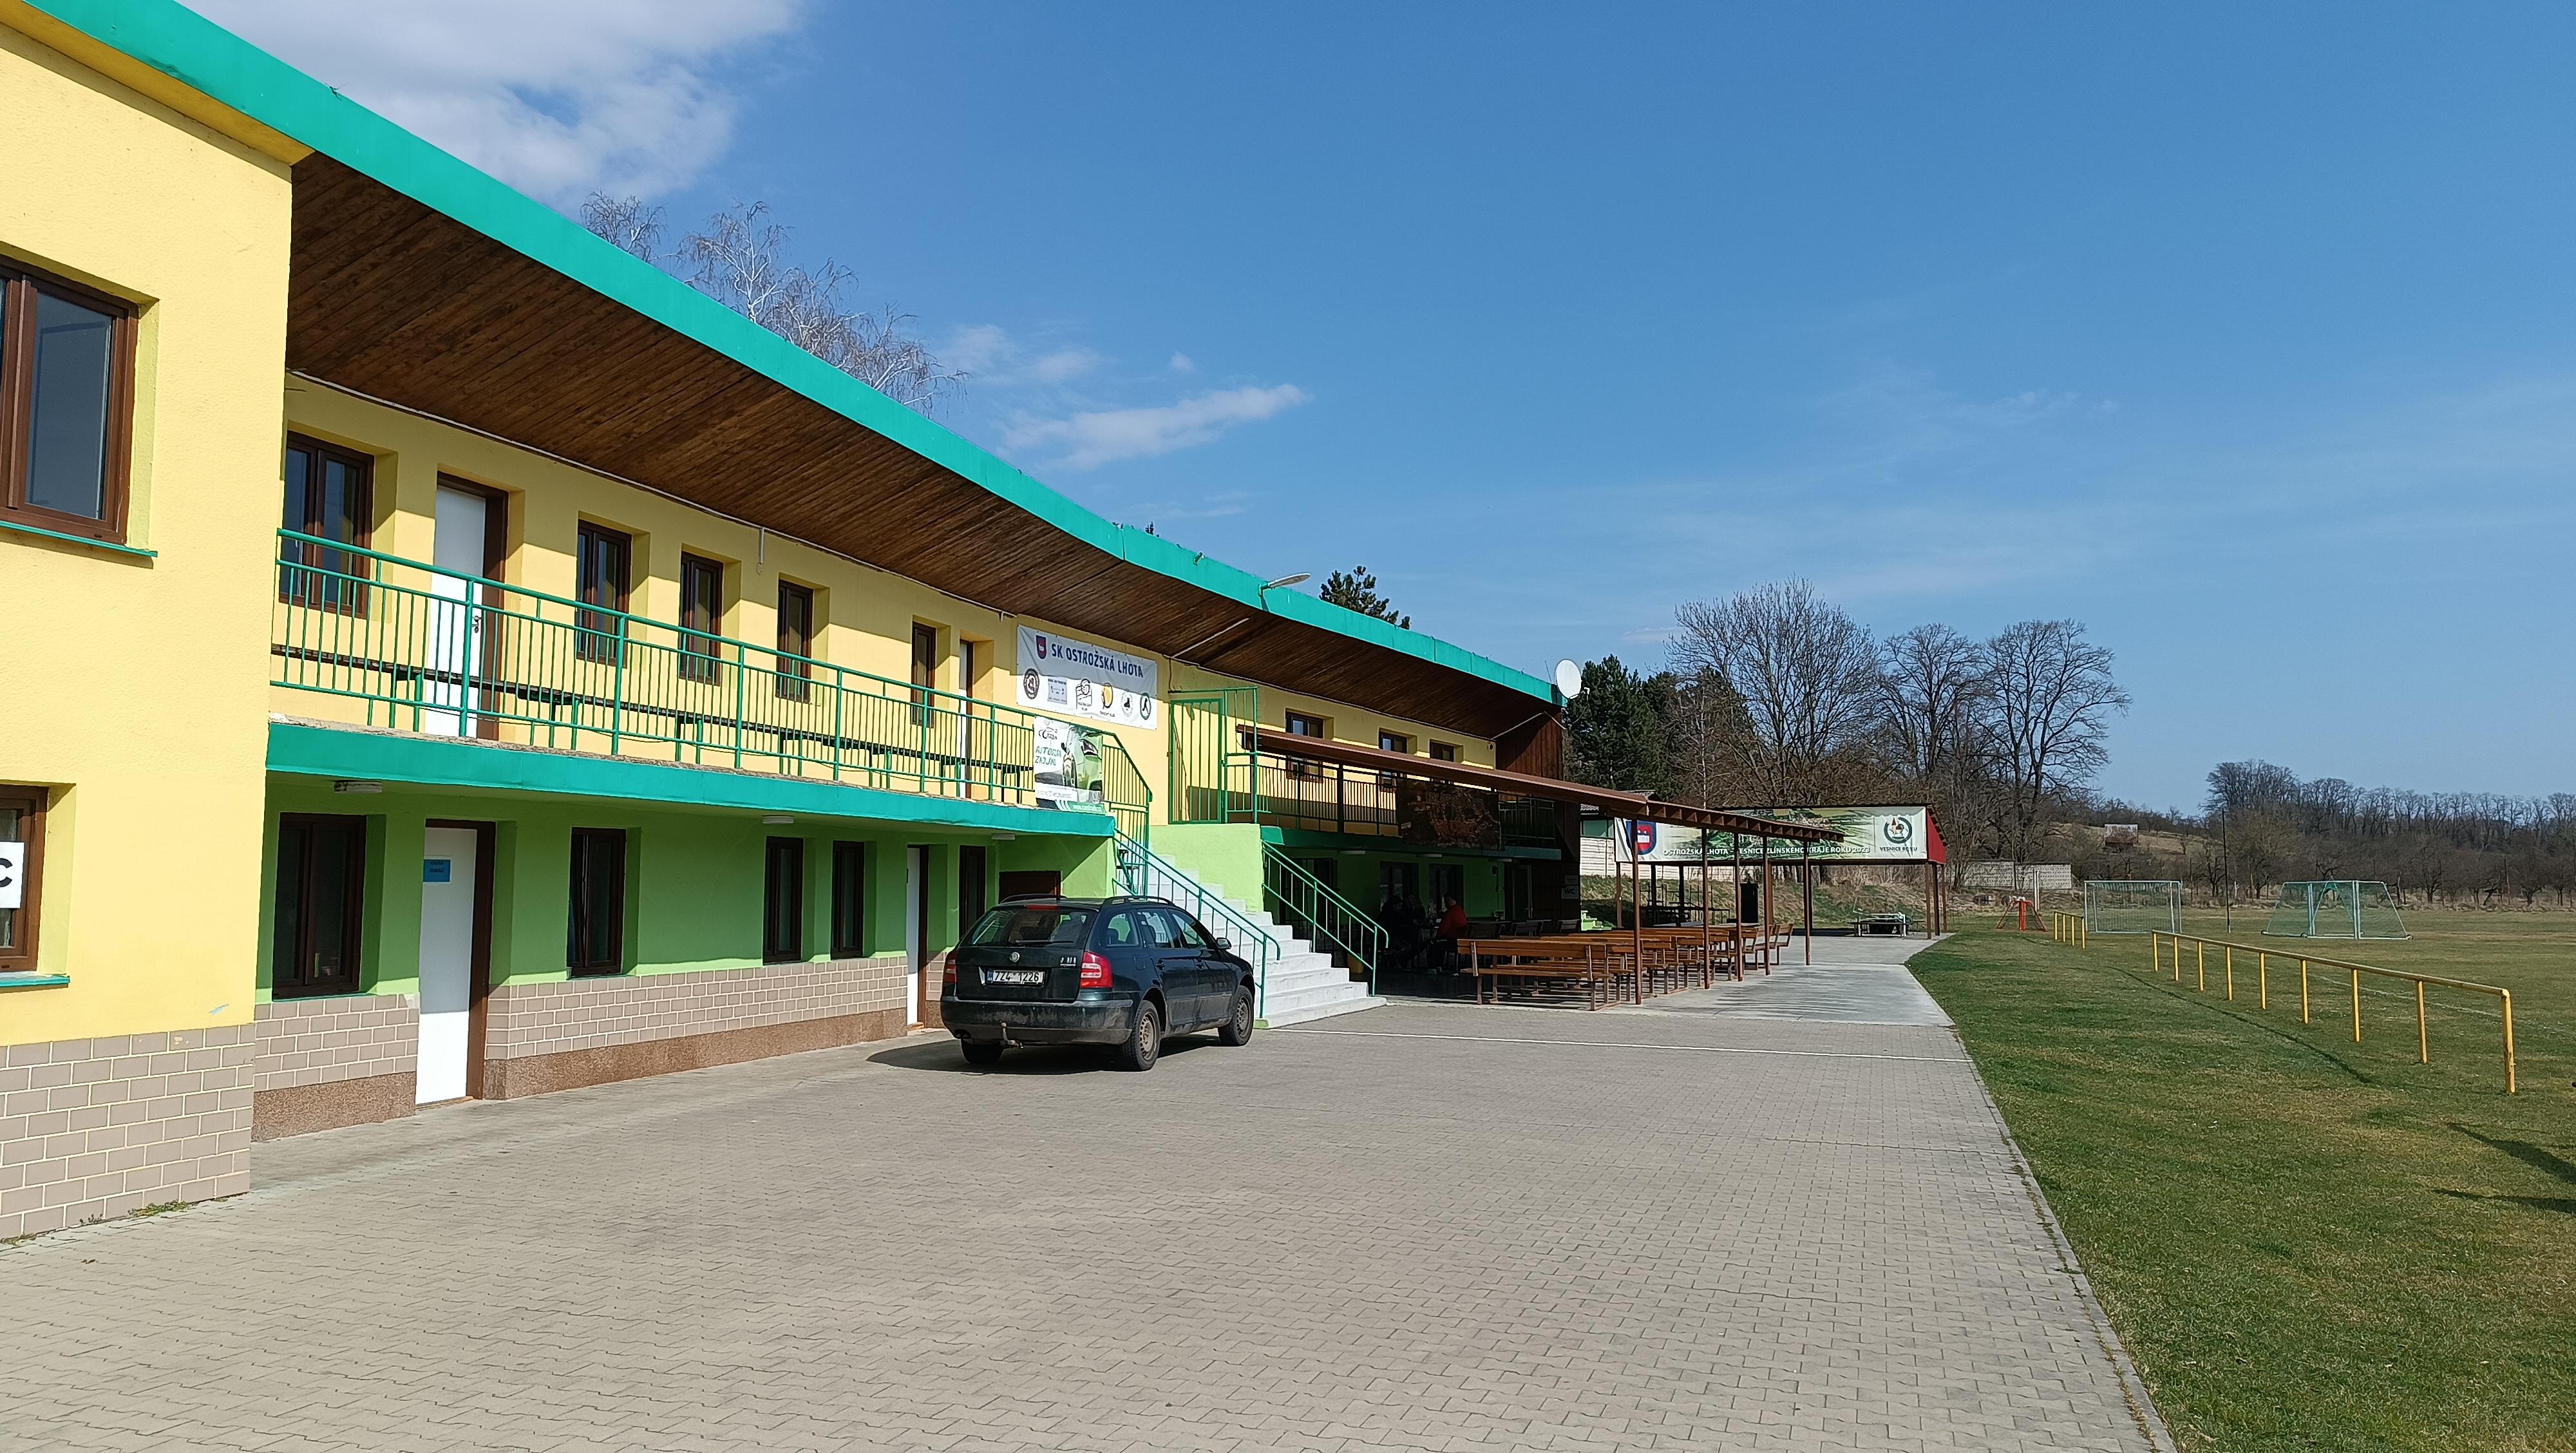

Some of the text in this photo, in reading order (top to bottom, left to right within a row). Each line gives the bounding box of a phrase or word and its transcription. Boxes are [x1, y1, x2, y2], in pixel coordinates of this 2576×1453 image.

[1051, 643, 1144, 678] SK OSTROŽSKÁ LHOTA
